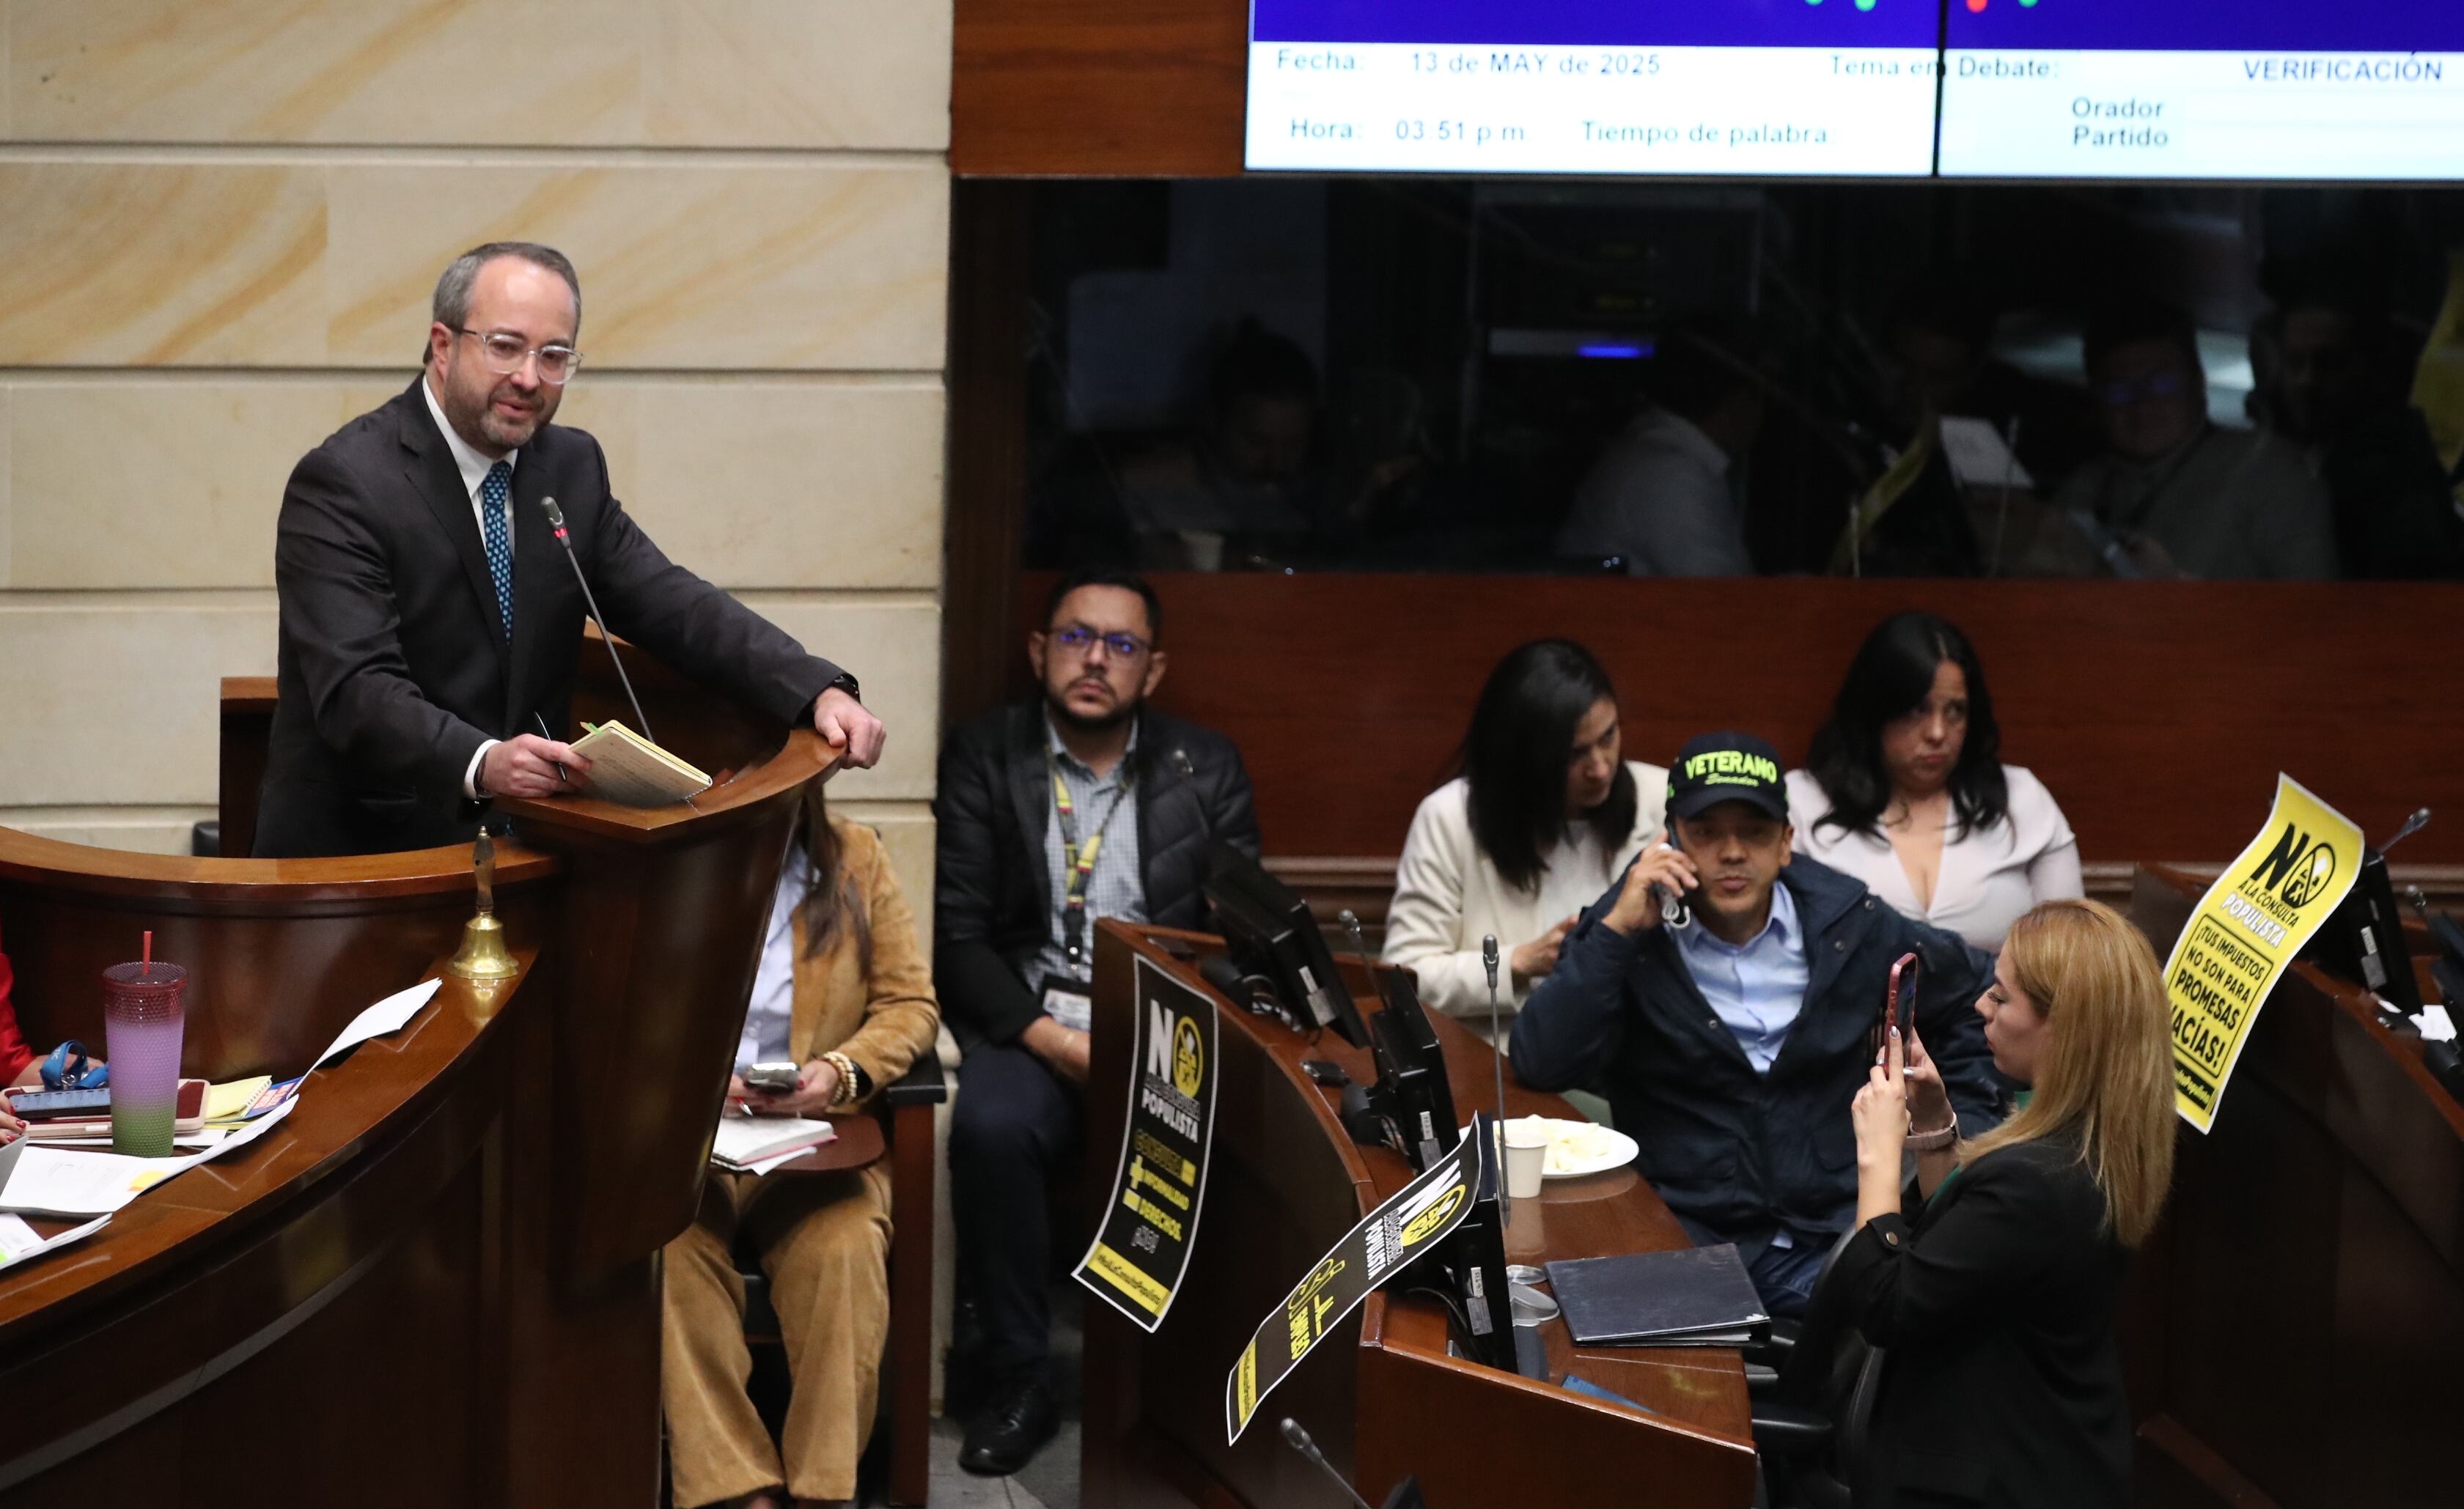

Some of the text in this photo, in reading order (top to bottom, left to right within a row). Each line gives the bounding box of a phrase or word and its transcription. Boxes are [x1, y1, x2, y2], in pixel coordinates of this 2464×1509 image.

[1278, 48, 1661, 74] Fecha: 13 de MAY de 2025
[1831, 55, 1900, 75] Tema
[1959, 56, 2059, 76] Debate:
[2243, 52, 2442, 81] VERIFICACIÓN
[1291, 117, 1362, 139] Hora:
[2073, 96, 2163, 118] Orador
[1582, 119, 1678, 147] Tiempo
[1689, 123, 1719, 142] de
[2074, 125, 2168, 147] Partido
[1685, 750, 1777, 783] VETERANO
[2220, 892, 2288, 949] POPULISTA
[2237, 880, 2300, 929] A LA CONSULTA
[2186, 945, 2251, 1004] NO SON PARA
[2216, 937, 2265, 981] IMPUESTOS
[2175, 968, 2240, 1030] PROMESAS
[2172, 1005, 2226, 1069] ACÍAS!
[1141, 1088, 1198, 1143] POPULISTA
[1364, 1218, 1387, 1280] POPULISTA
